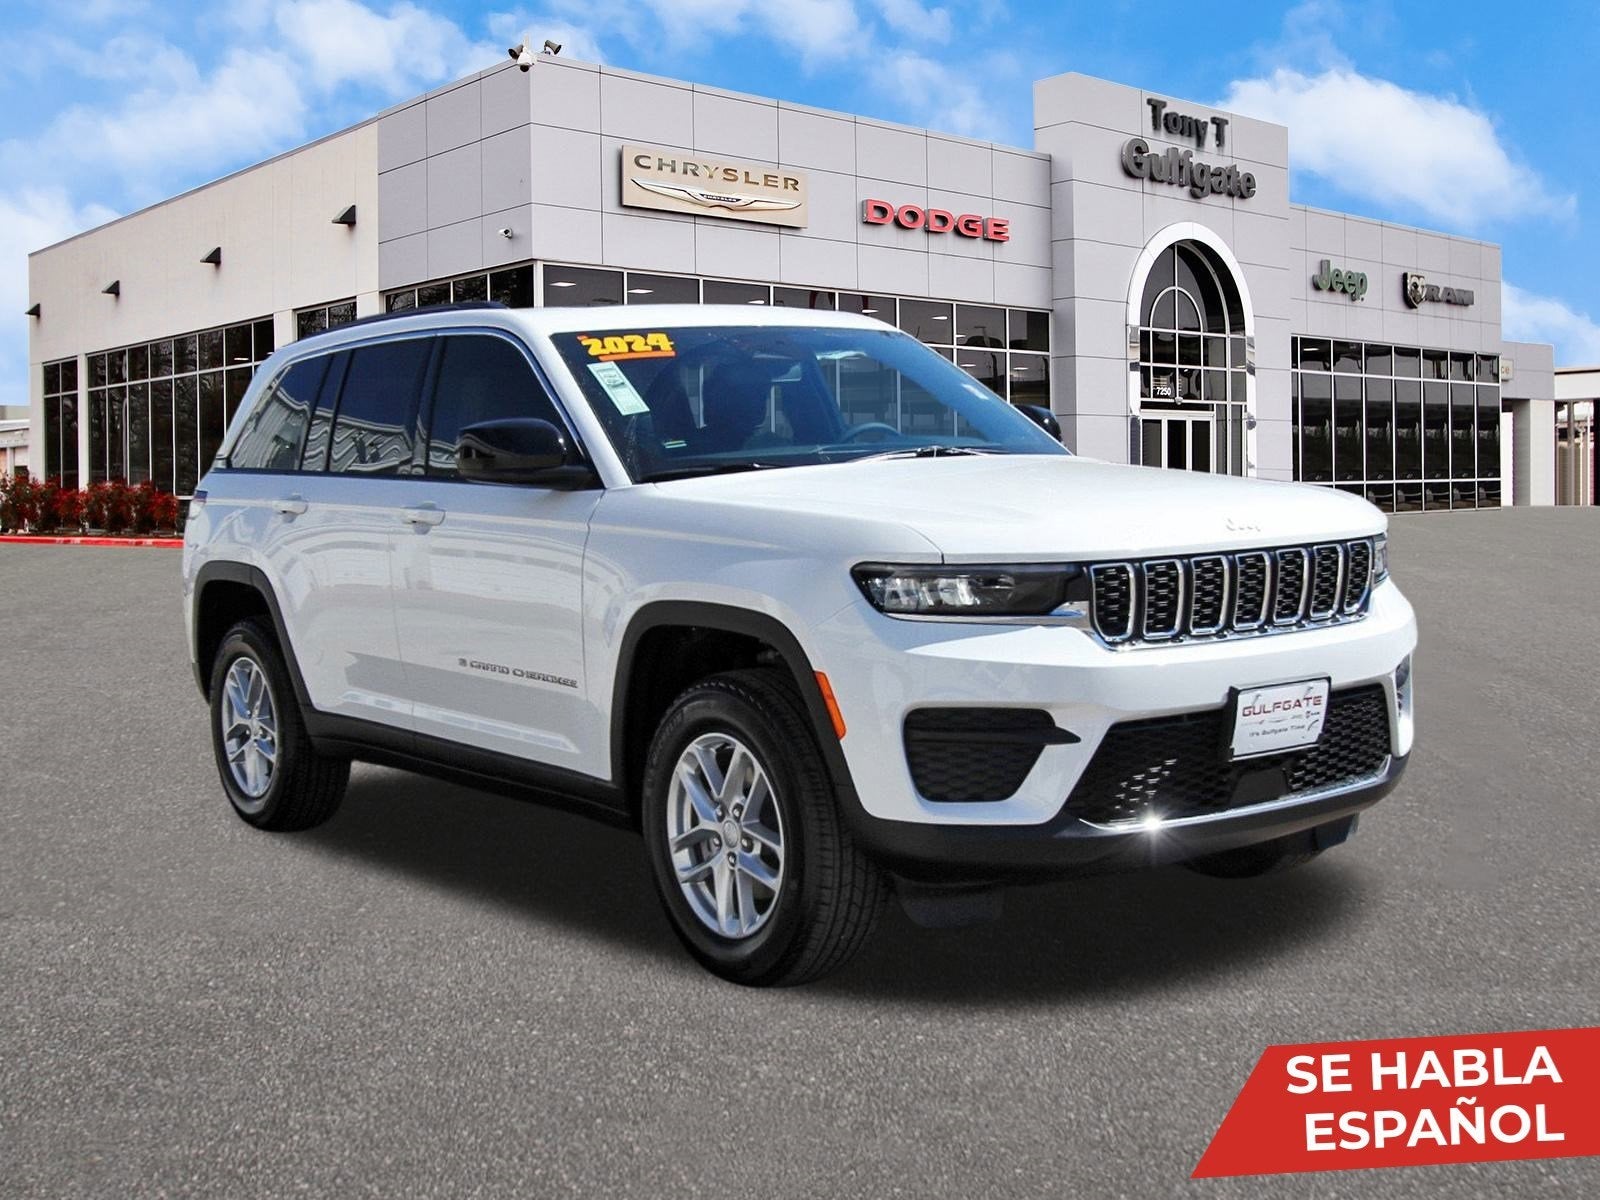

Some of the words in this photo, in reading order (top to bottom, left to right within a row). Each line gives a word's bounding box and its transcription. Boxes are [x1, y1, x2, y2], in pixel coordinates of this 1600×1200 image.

[1147, 98, 1208, 148] Tony
[1210, 116, 1229, 147] T
[633, 154, 800, 192] CHRYSLER
[1121, 138, 1257, 199] Gulfgate
[862, 199, 1010, 242] DODGE
[1311, 259, 1368, 302] Jeep
[1424, 284, 1475, 307] RAM
[581, 333, 674, 356] 2024
[1156, 386, 1172, 396] 7250
[469, 660, 510, 675] GRAND
[512, 668, 578, 689] CHEROKEE
[1242, 695, 1323, 717] GULFGATE
